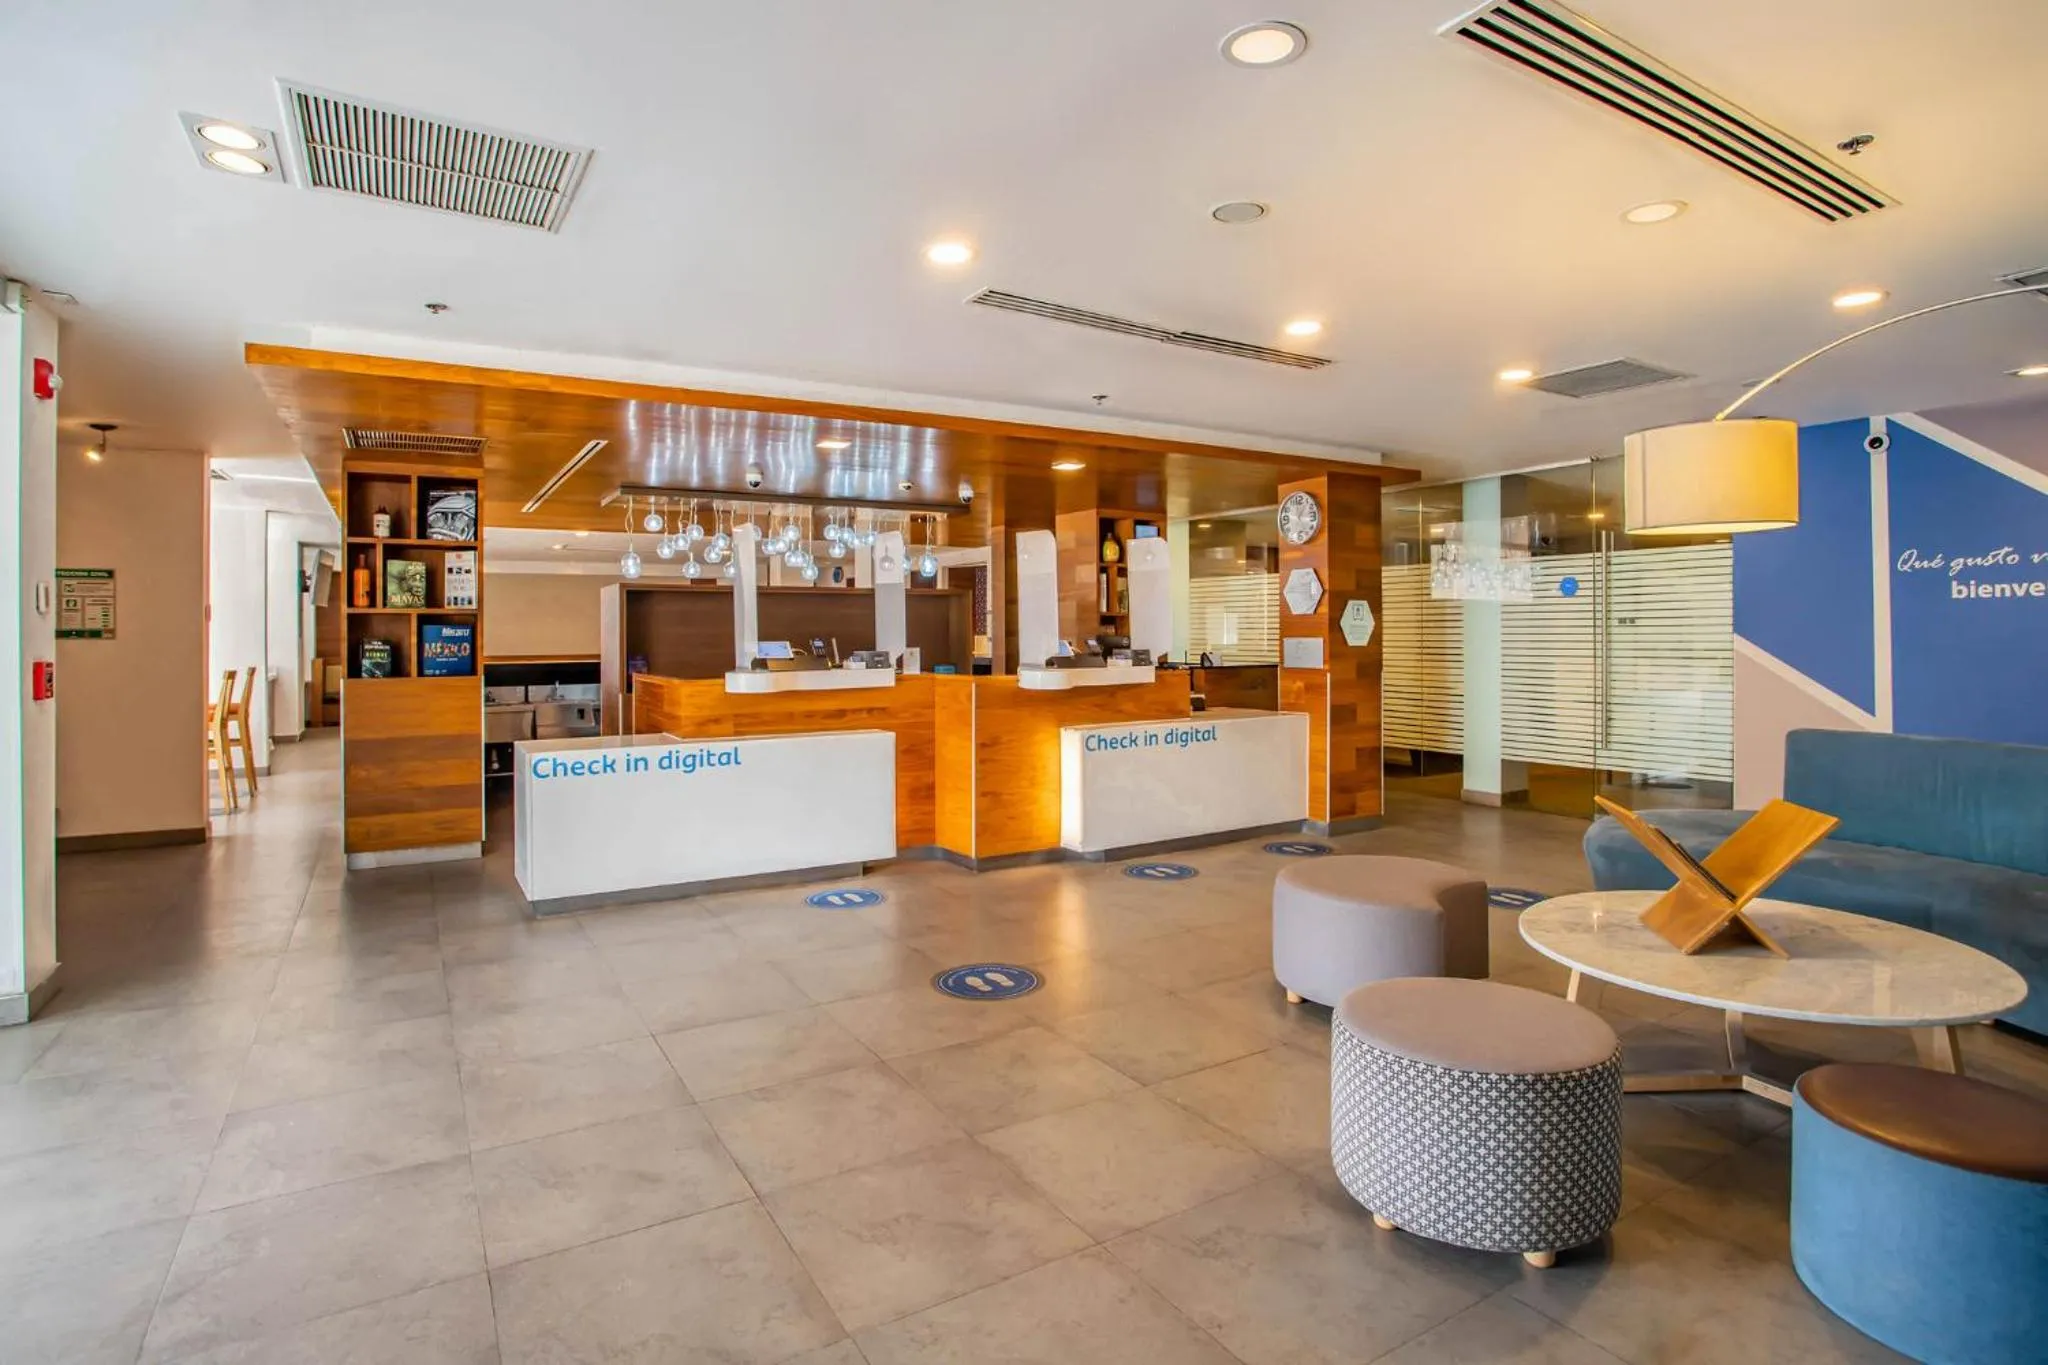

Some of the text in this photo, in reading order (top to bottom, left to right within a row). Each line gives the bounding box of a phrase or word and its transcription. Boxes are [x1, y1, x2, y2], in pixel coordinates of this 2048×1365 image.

[1897, 549, 1945, 572] Qué
[1949, 546, 2020, 576] gusto
[1085, 725, 1217, 751] Check in digital
[532, 746, 742, 779] Check in digital
